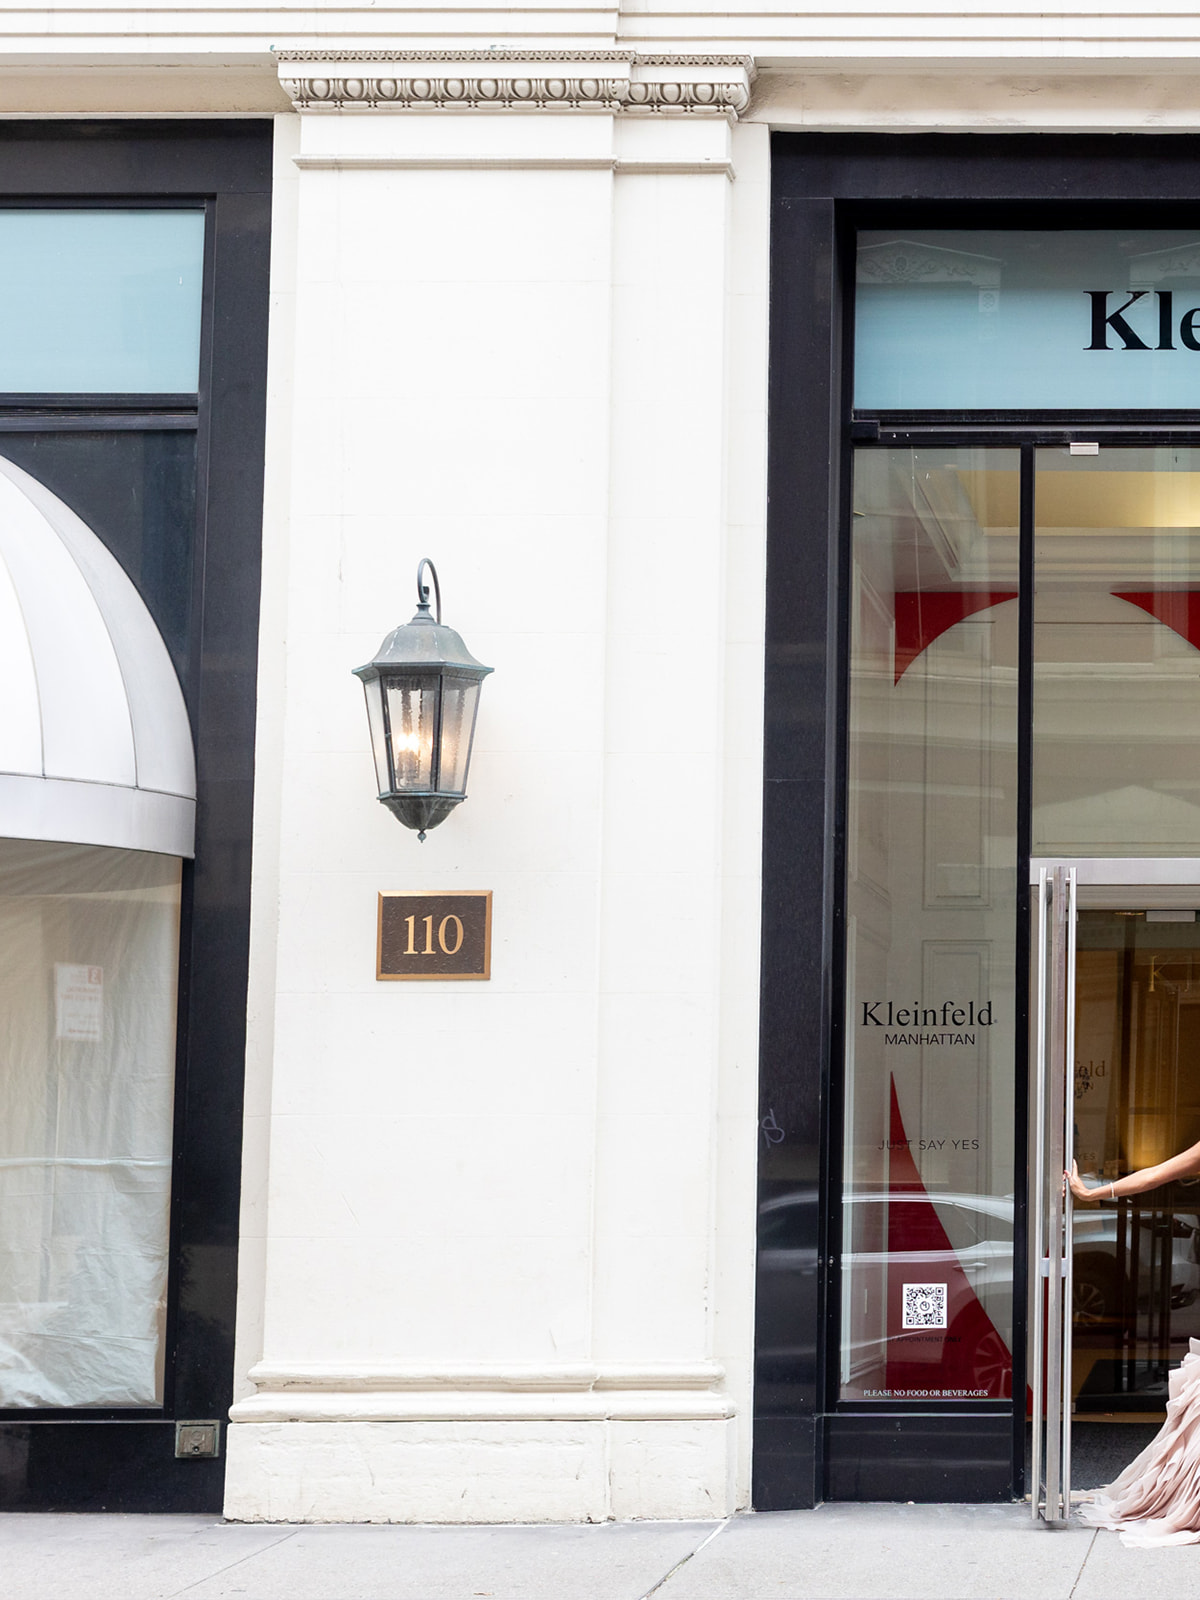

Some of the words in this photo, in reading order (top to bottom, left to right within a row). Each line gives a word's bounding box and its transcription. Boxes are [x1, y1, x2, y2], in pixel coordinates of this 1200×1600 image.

[403, 914, 464, 955] 110
[861, 1001, 994, 1026] Kleinfeld
[884, 1033, 976, 1045] MANHATTAN
[878, 1139, 912, 1150] JUST
[918, 1139, 946, 1150] SAY
[951, 1139, 979, 1150] YES
[863, 1389, 892, 1397] PLEASE
[893, 1389, 906, 1397] NO
[906, 1389, 928, 1397] FOOD
[929, 1389, 941, 1397] OR
[942, 1389, 989, 1397] BEVERAGES
